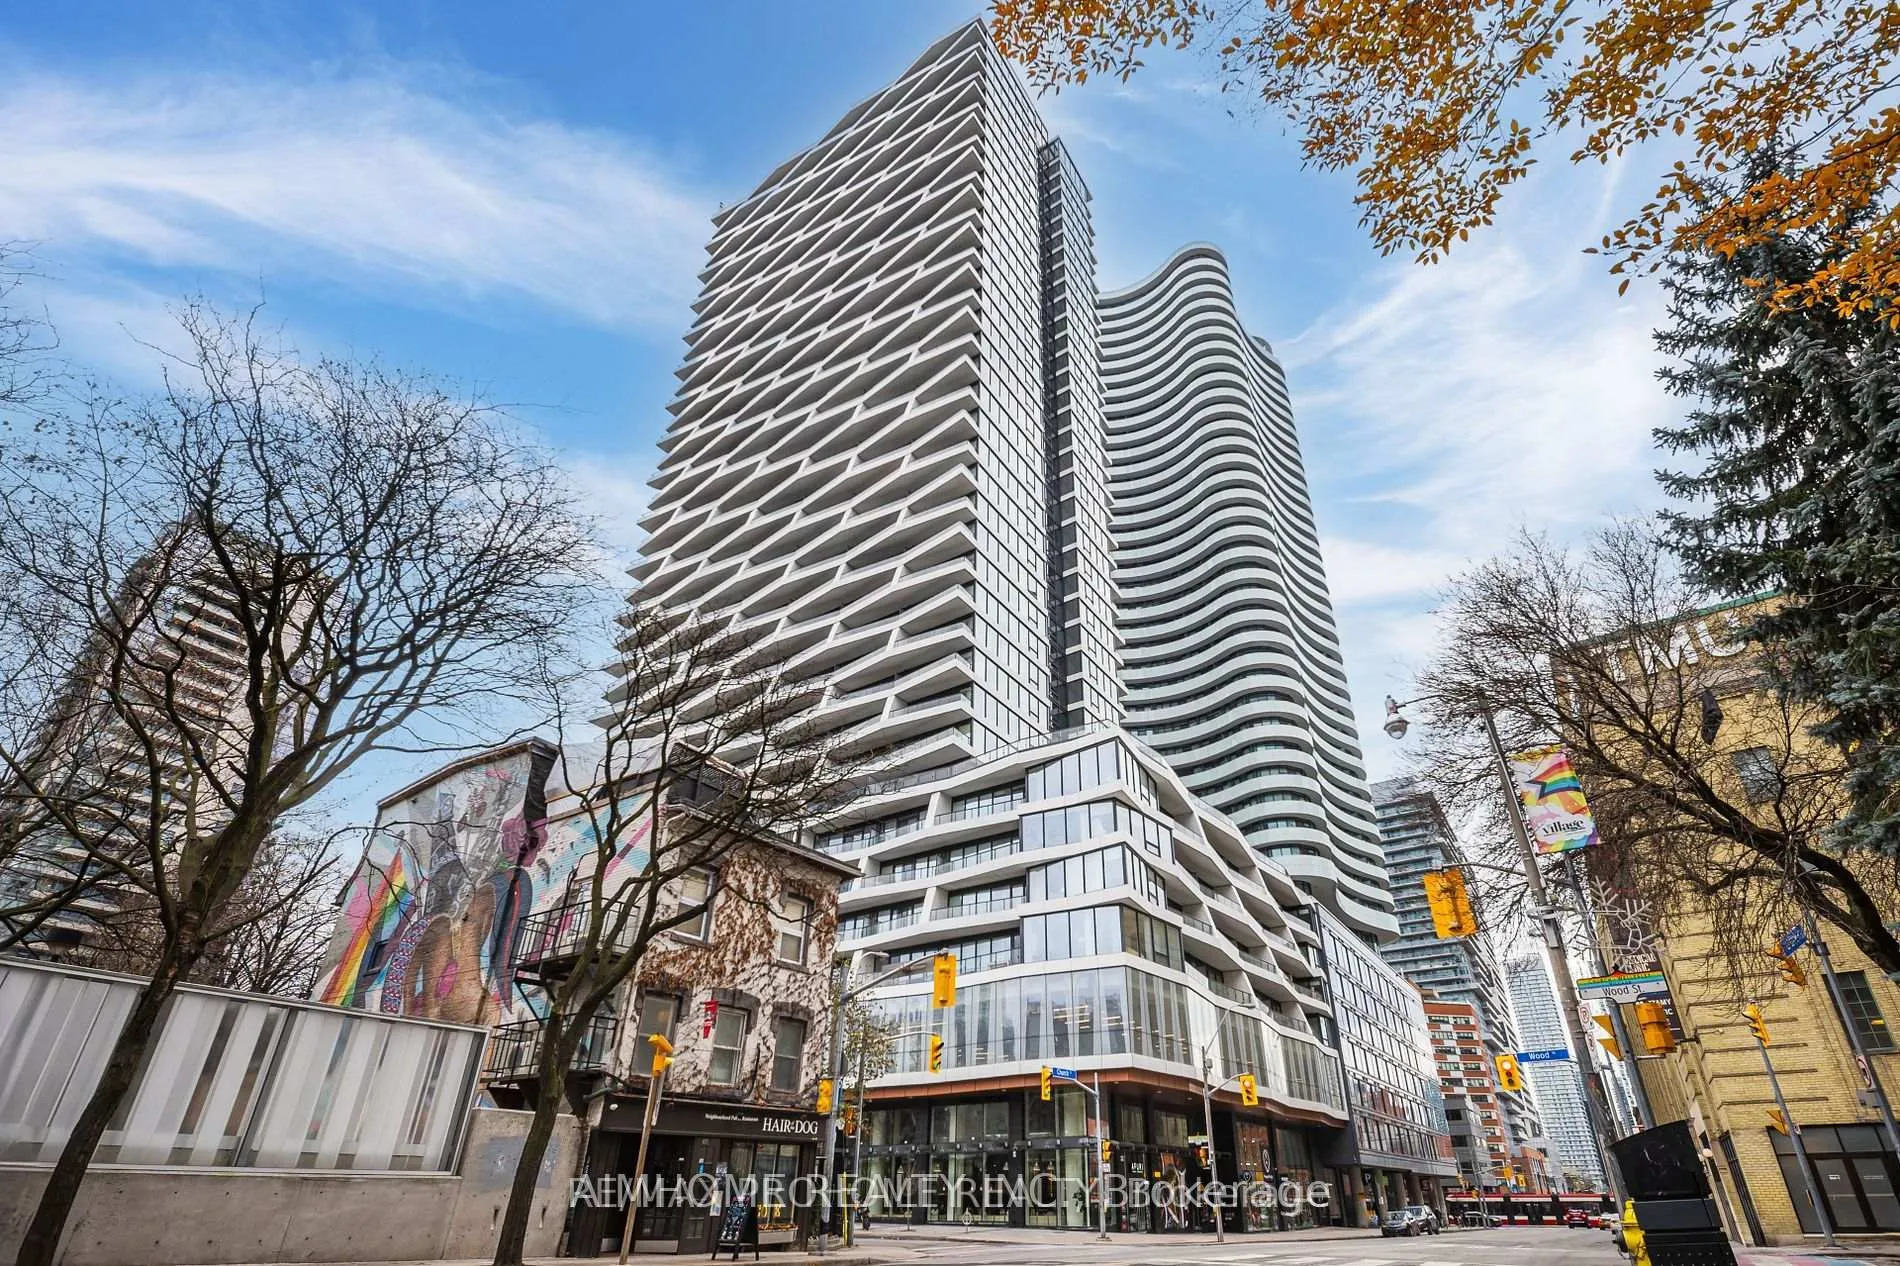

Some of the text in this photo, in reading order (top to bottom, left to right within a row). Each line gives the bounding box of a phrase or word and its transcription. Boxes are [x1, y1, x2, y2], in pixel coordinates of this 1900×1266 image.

[1602, 986, 1629, 997] Wood
[1528, 1052, 1550, 1060] Wood
[762, 1116, 791, 1134] HAIR
[794, 1120, 818, 1135] DOG
